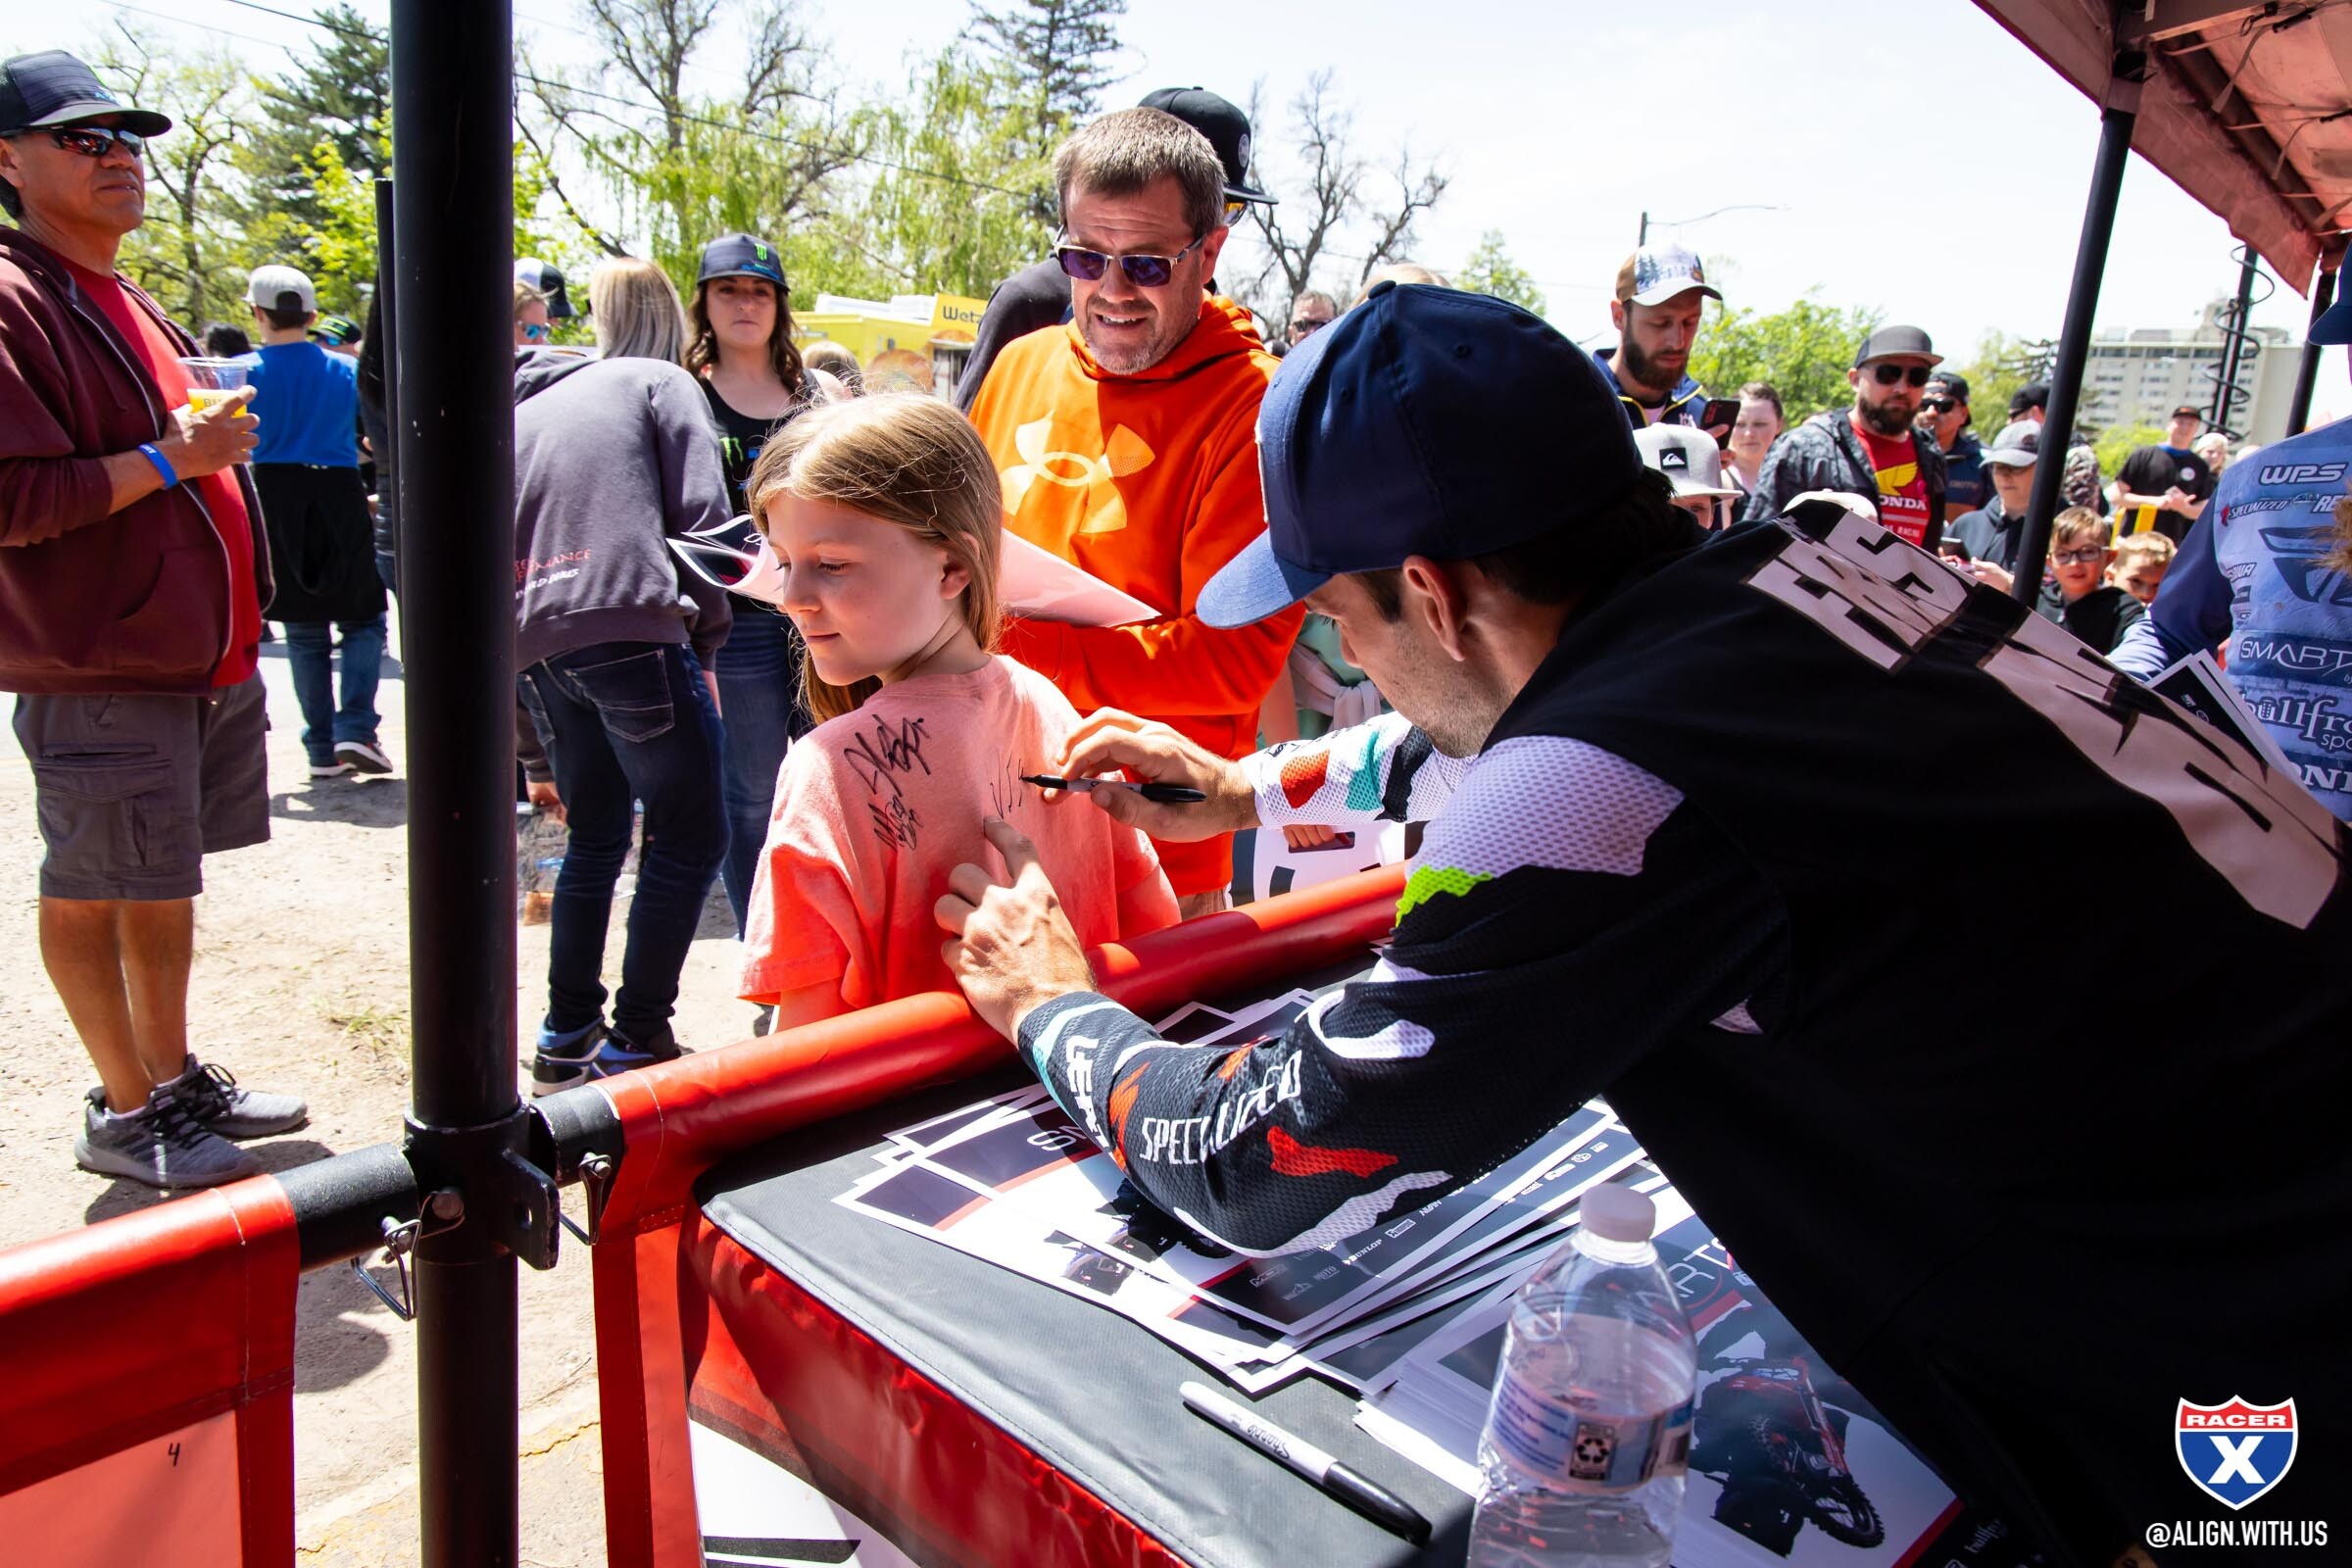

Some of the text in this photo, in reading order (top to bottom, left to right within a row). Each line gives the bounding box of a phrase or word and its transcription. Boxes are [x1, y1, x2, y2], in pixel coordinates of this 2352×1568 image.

[2259, 463, 2349, 485] WPS
[1879, 495, 1928, 511] ONDA
[2229, 500, 2290, 519] SPECIALIZED
[168, 1442, 180, 1467] 4
